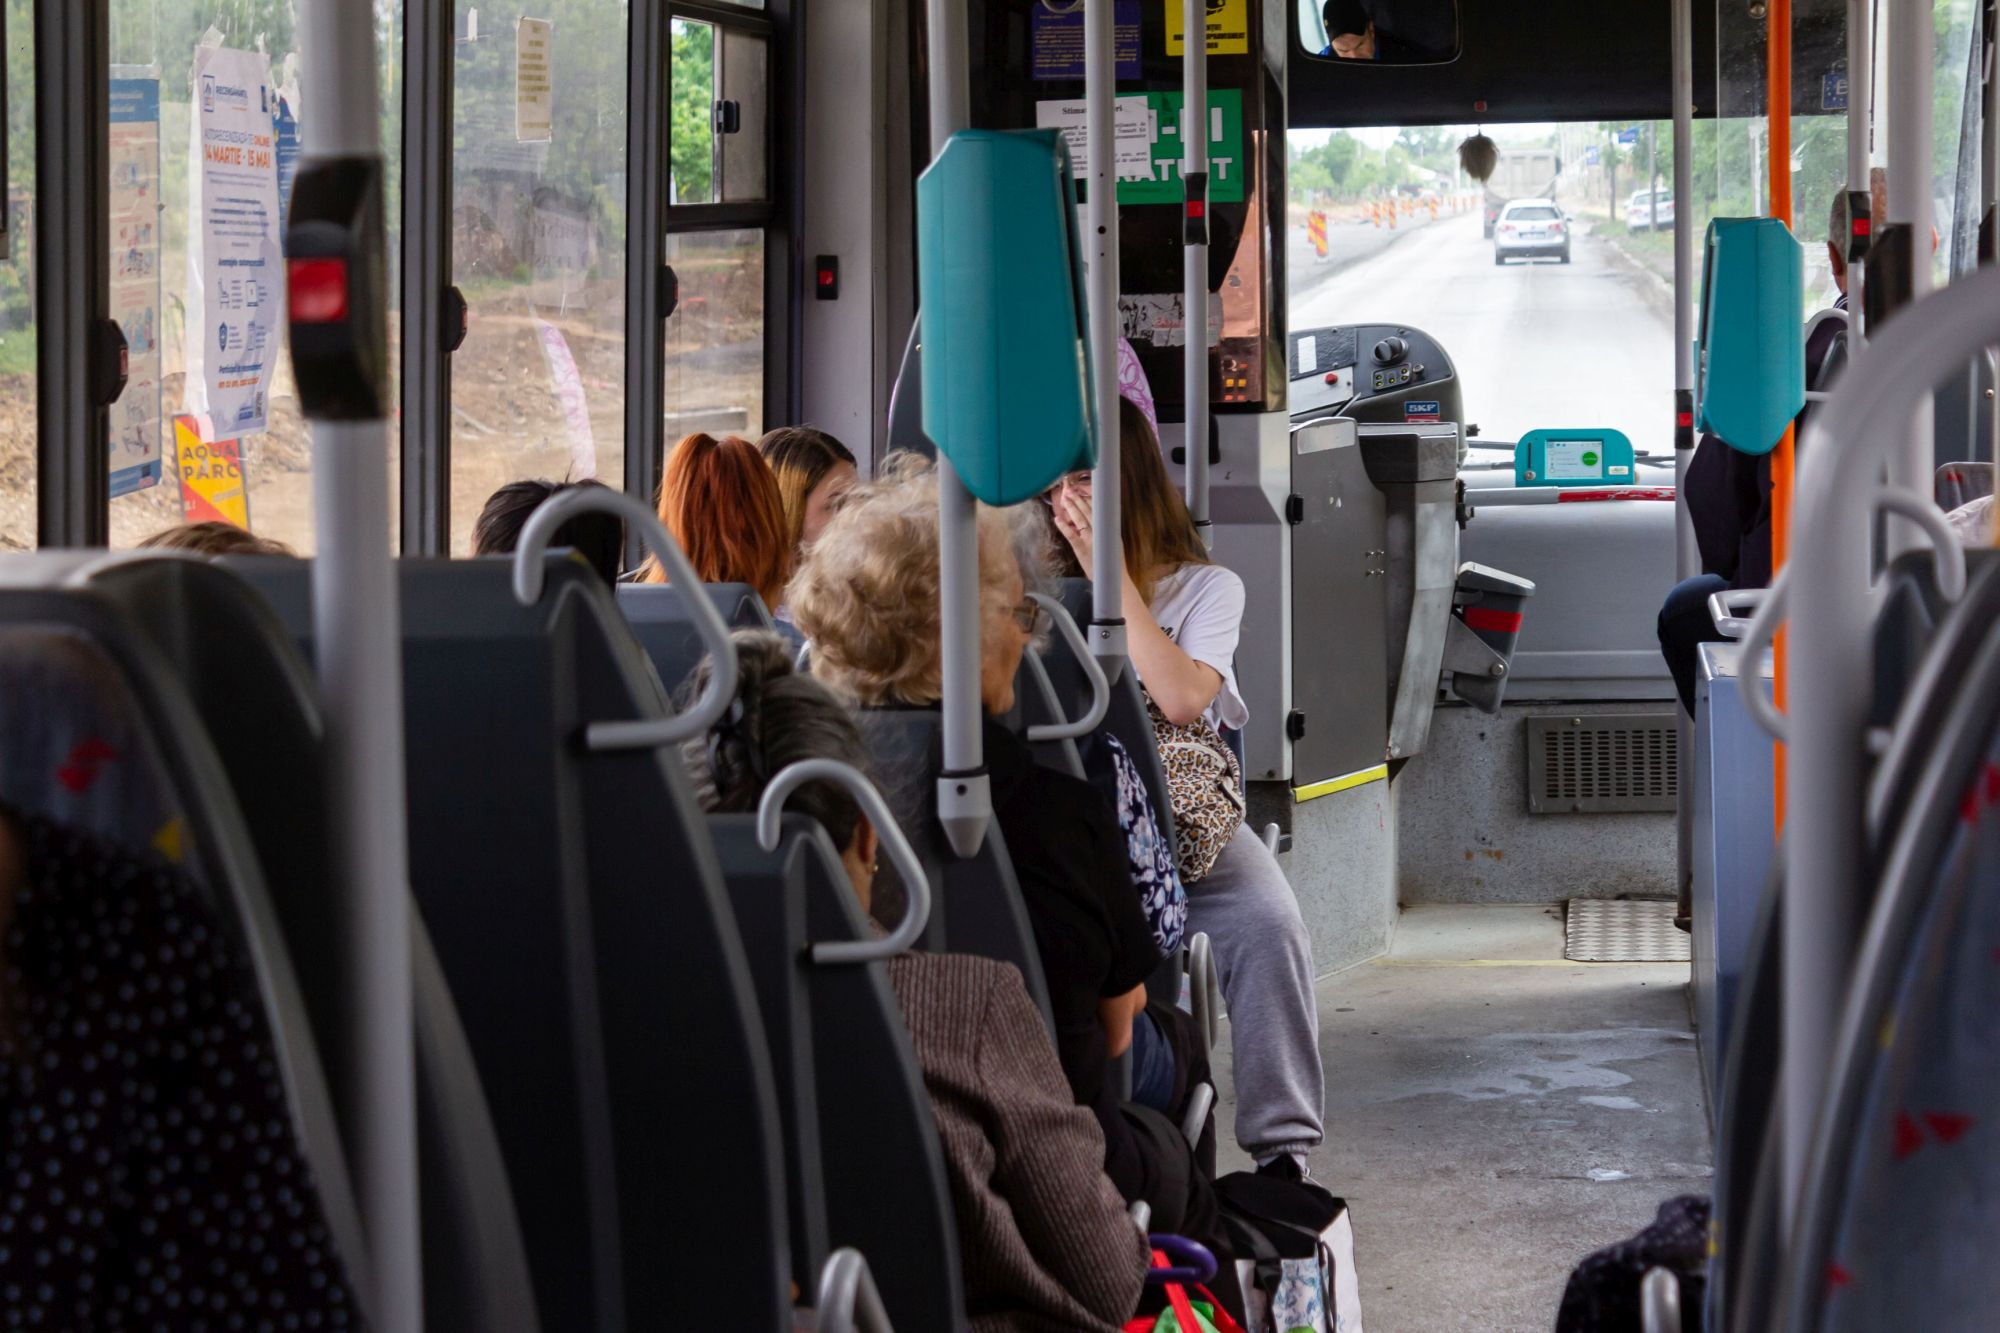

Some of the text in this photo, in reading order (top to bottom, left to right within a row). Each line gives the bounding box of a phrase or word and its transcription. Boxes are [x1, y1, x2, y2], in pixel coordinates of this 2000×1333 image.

[213, 146, 242, 165] MARTIE
[256, 152, 271, 168] MAI
[1409, 404, 1436, 412] SKF
[183, 444, 236, 460] AQUA
[183, 462, 239, 480] PARC
